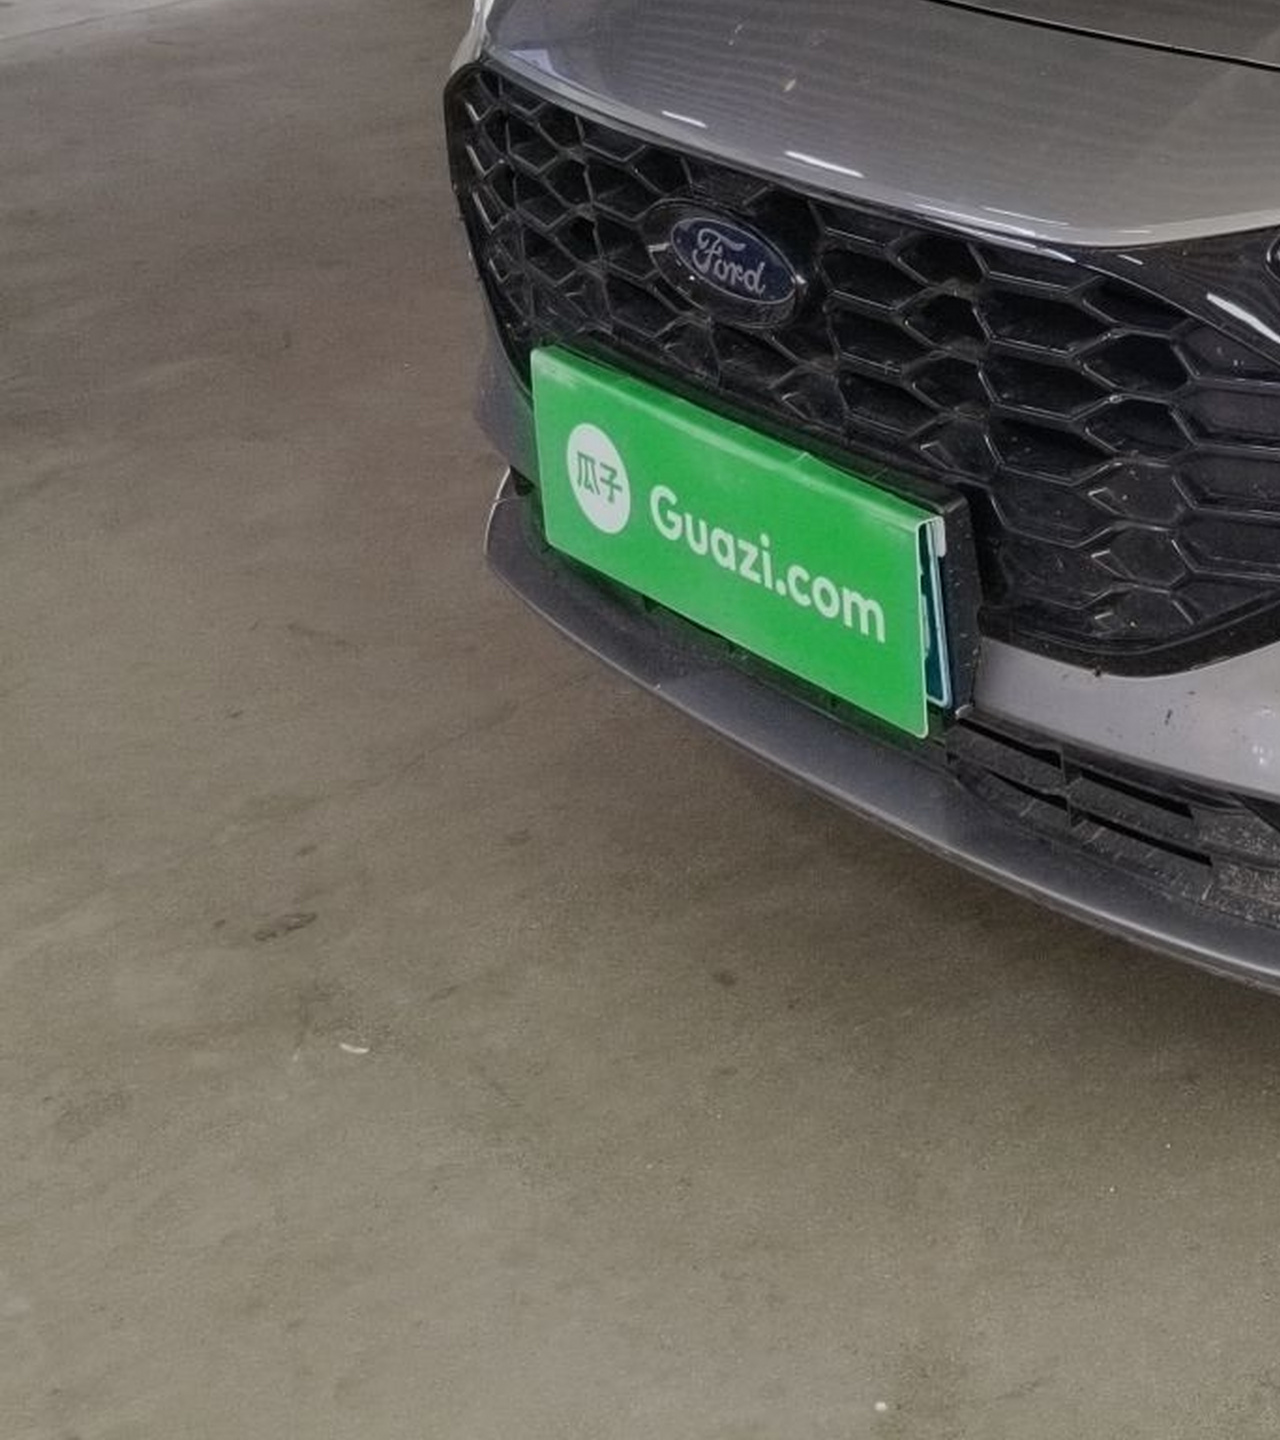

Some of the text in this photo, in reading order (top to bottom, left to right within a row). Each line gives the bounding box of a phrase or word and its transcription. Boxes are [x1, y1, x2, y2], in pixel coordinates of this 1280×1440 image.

[691, 227, 766, 295] Ford
[576, 449, 623, 504] 瓜子
[649, 484, 887, 645] Guazi.com
